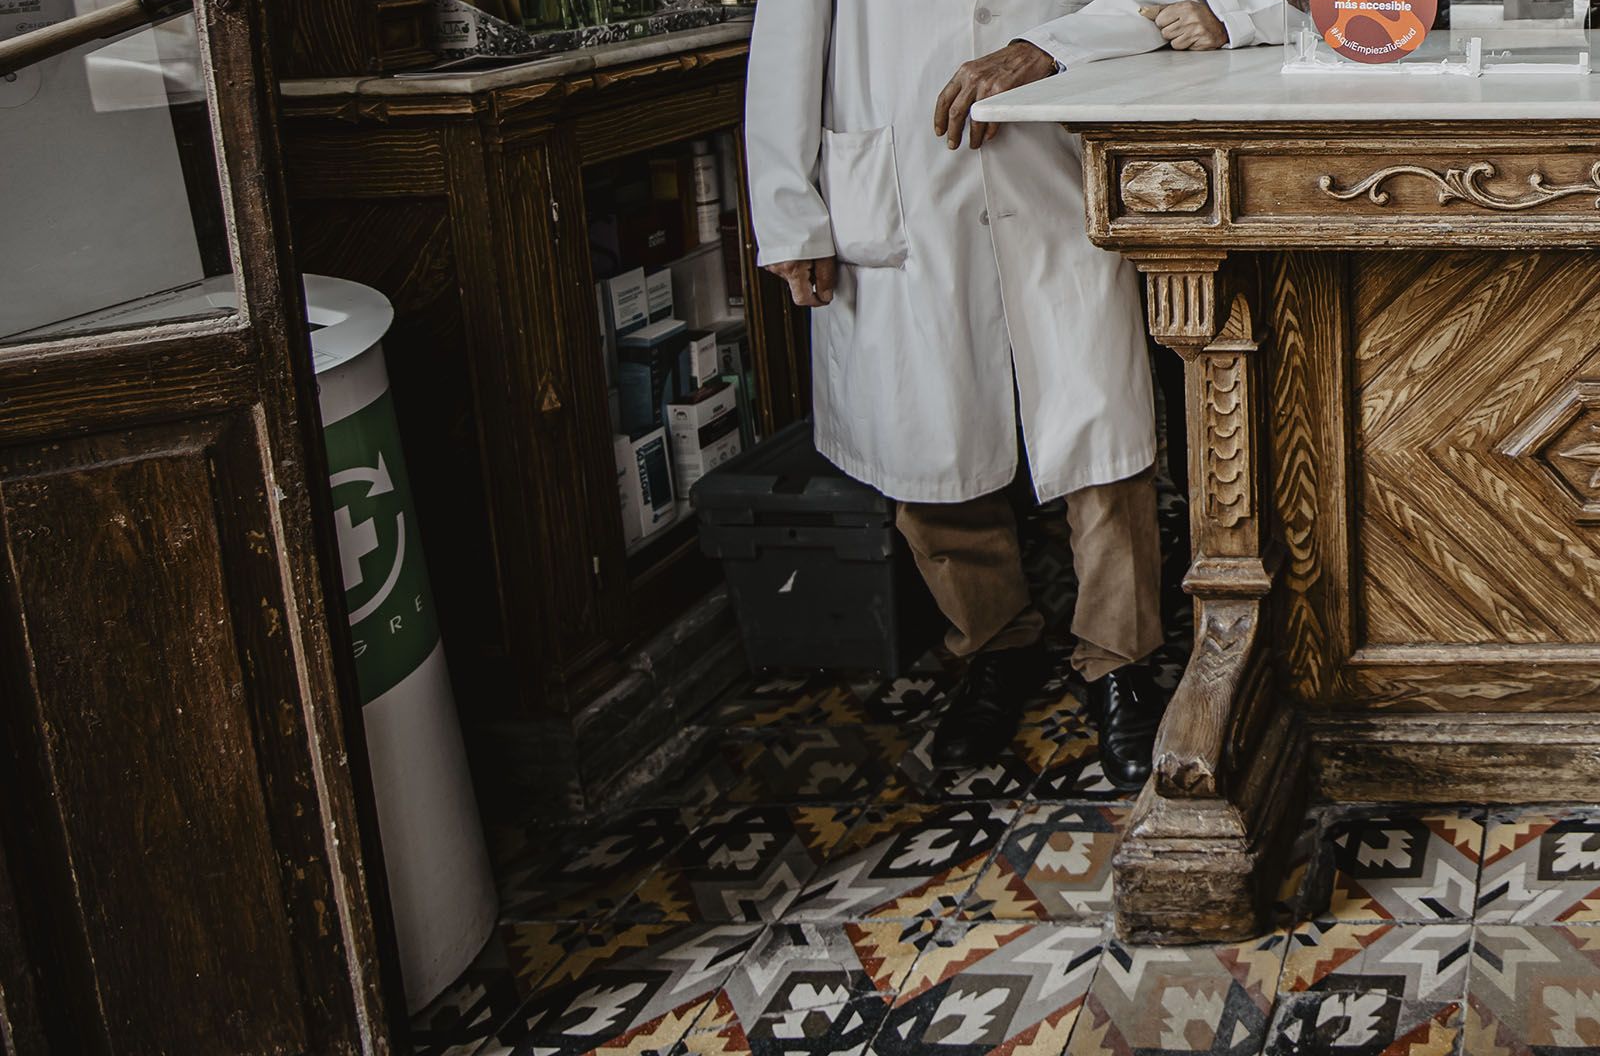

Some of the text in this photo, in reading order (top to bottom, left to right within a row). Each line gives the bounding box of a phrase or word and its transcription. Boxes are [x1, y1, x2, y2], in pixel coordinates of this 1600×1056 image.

[1334, 0, 1412, 12] más accesible
[1330, 27, 1417, 56] #AquíEmpiezaTuSalud
